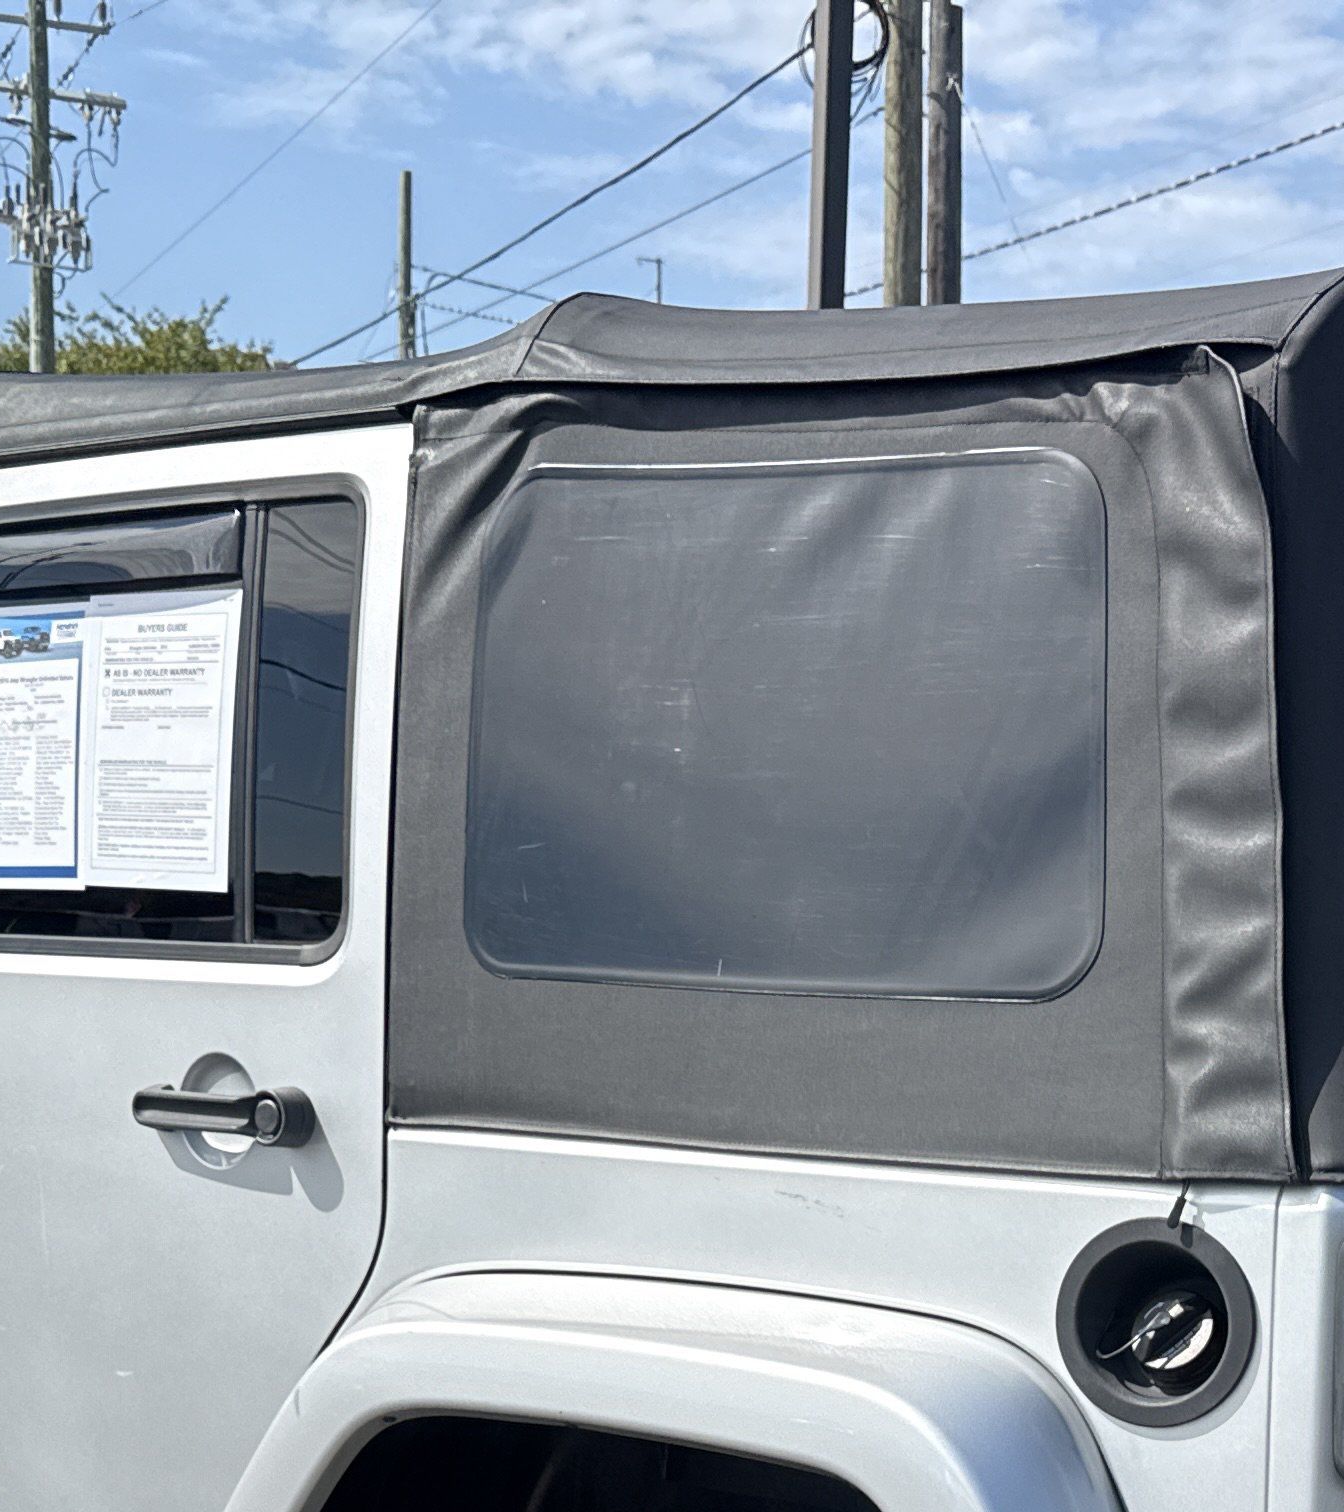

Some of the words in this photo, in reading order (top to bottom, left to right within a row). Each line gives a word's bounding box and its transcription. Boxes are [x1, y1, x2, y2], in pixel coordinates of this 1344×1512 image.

[137, 624, 165, 633] BUYERS
[166, 623, 188, 632] GUIDE
[144, 669, 168, 677] DEALER
[170, 668, 206, 676] WARRANTY
[111, 688, 136, 697] DEALER
[137, 688, 172, 697] WARRANTY
